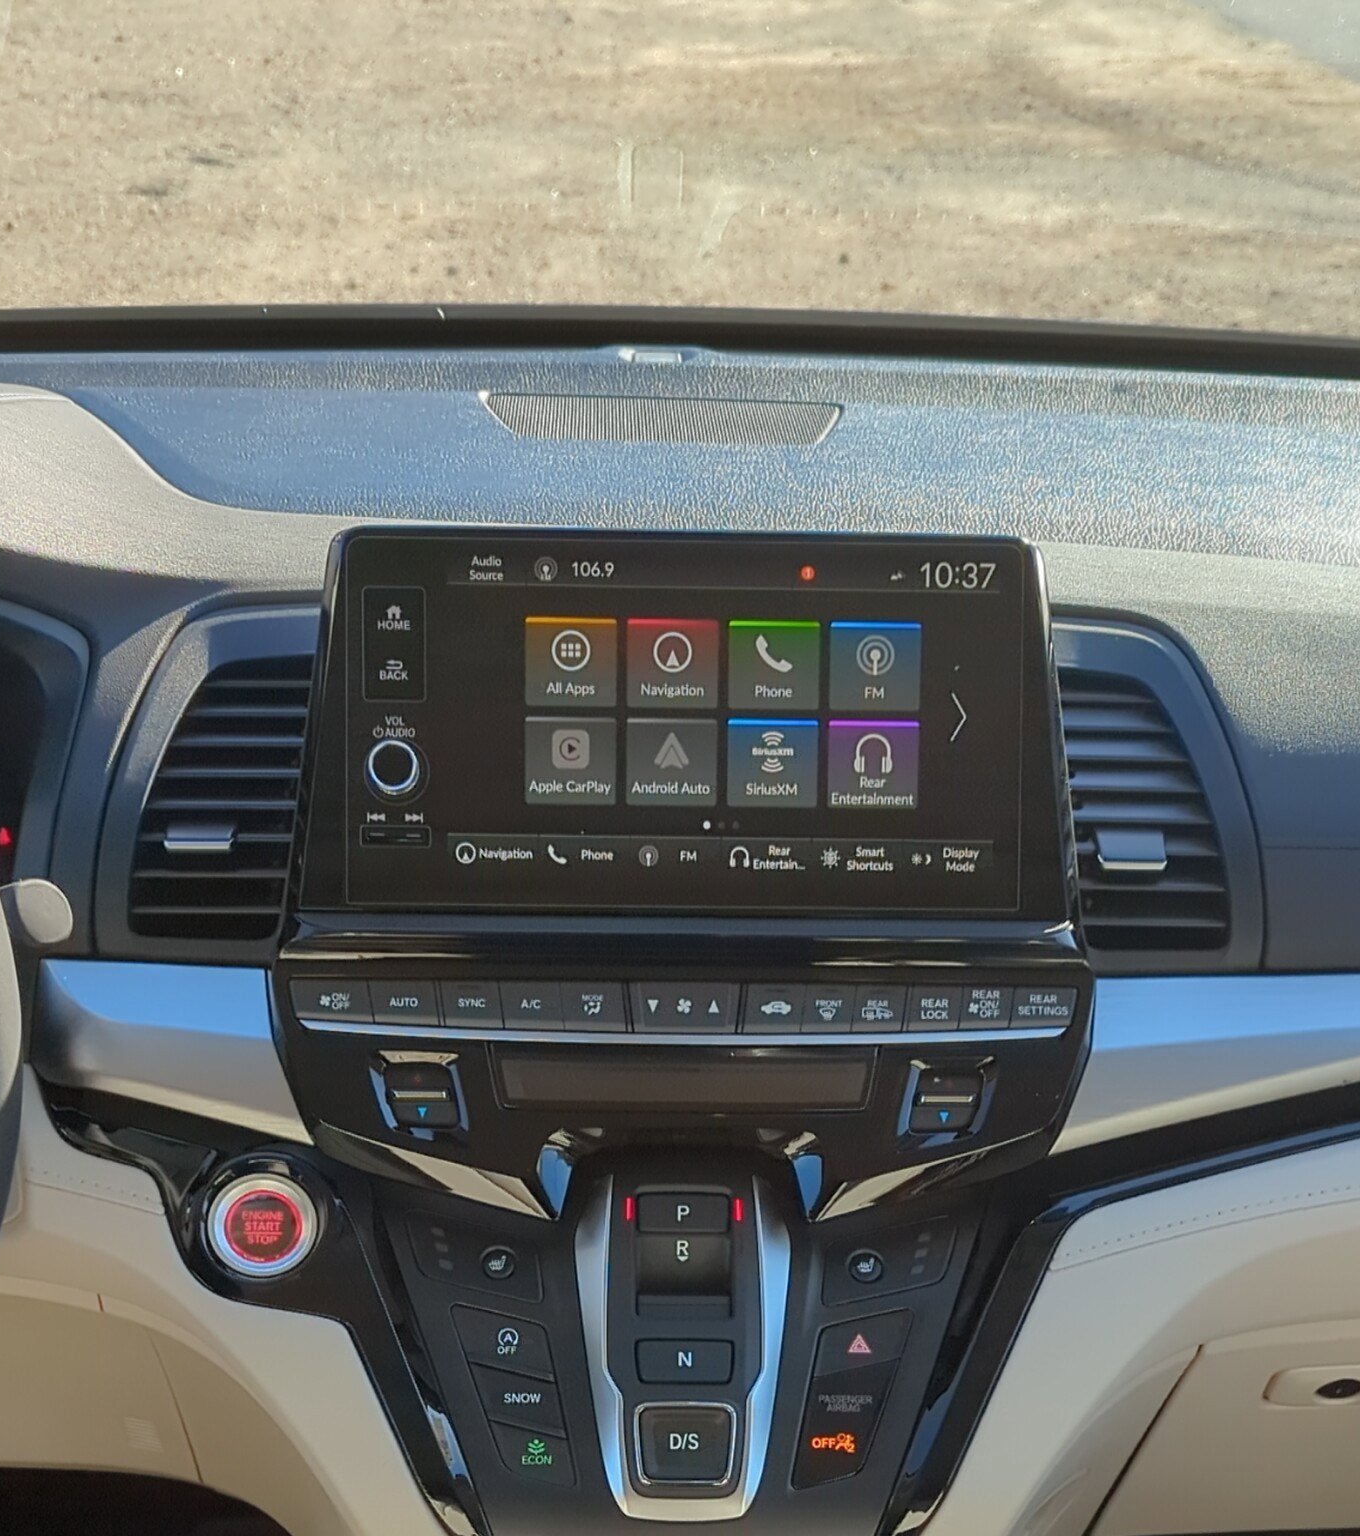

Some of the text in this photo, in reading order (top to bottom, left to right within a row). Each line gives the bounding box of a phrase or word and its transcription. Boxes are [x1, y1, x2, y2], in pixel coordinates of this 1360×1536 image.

[471, 555, 502, 567] Audio
[571, 562, 615, 578] 106.9
[920, 562, 997, 589] 10:37
[469, 570, 504, 582] Source
[377, 620, 411, 631] HOME
[379, 670, 408, 681] BACK
[546, 682, 595, 697] All Apps
[640, 684, 704, 698] Navigation
[755, 685, 793, 698] Phone
[864, 687, 885, 699] FM
[384, 716, 405, 727] VOL
[385, 728, 415, 738] AUDIO
[529, 780, 612, 795] Apple CarPlay
[860, 776, 886, 789] Rear
[632, 782, 710, 795] Android Auto
[745, 783, 798, 796] SiriusXM
[831, 792, 914, 806] Entertainment
[479, 848, 533, 861] Navigation
[581, 849, 614, 861] Phone
[768, 845, 791, 856] Rear
[855, 846, 885, 858] Smart
[942, 847, 979, 861] Display
[680, 851, 697, 862] FM
[846, 860, 893, 872] Shortcuts
[946, 861, 975, 873] Mode
[972, 990, 1000, 999] REAR
[1029, 994, 1057, 1004] REAR
[331, 1001, 350, 1010] OFF
[390, 997, 418, 1007] AUTO
[458, 998, 486, 1008] SYNC
[521, 999, 541, 1009] A/C
[815, 1000, 843, 1008] FRONT
[921, 998, 949, 1008] REAR
[980, 1000, 999, 1009] ON/
[921, 1010, 949, 1020] LOCK
[980, 1009, 1000, 1018] OFF
[1018, 1006, 1069, 1016] SETTINGS
[242, 1211, 284, 1220] ENGINE
[677, 1205, 690, 1221] P
[244, 1222, 281, 1231] START
[246, 1235, 278, 1245] STOP
[676, 1240, 689, 1256] R
[497, 1345, 517, 1355] OFF
[678, 1351, 692, 1367] N
[503, 1393, 541, 1404] SNOW
[818, 1394, 872, 1404] PASSENGER
[826, 1403, 861, 1412] AIRBAG
[669, 1433, 699, 1450] D/S
[812, 1437, 836, 1449] OFF
[521, 1455, 552, 1465] ECON
